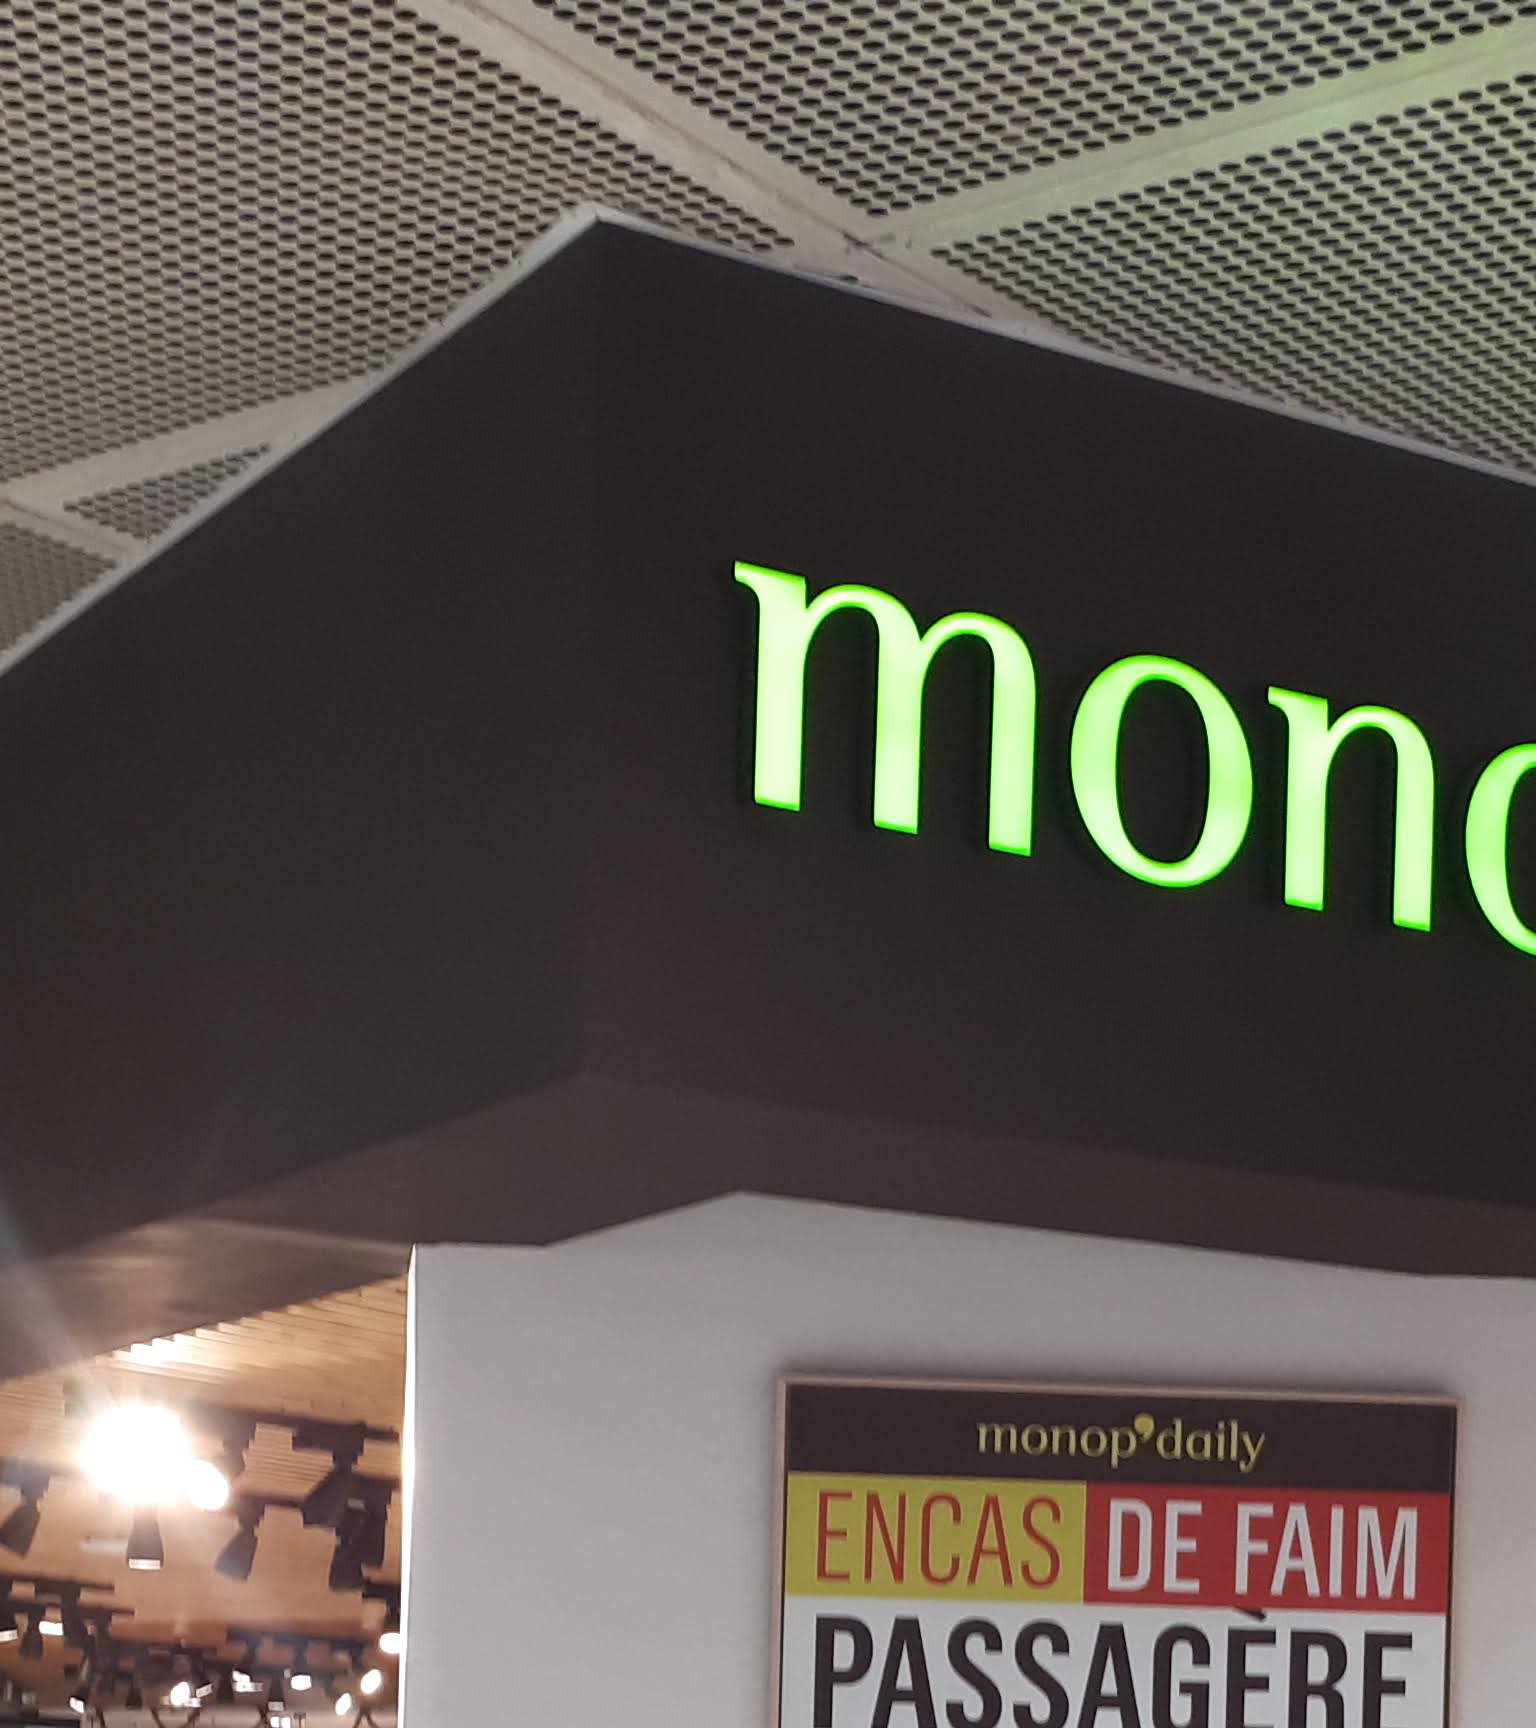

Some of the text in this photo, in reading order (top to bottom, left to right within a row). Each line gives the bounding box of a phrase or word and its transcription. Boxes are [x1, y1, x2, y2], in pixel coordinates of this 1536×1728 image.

[975, 1412, 1266, 1474] monop'daily
[814, 1488, 1419, 1601] ENCAS DE FAIM
